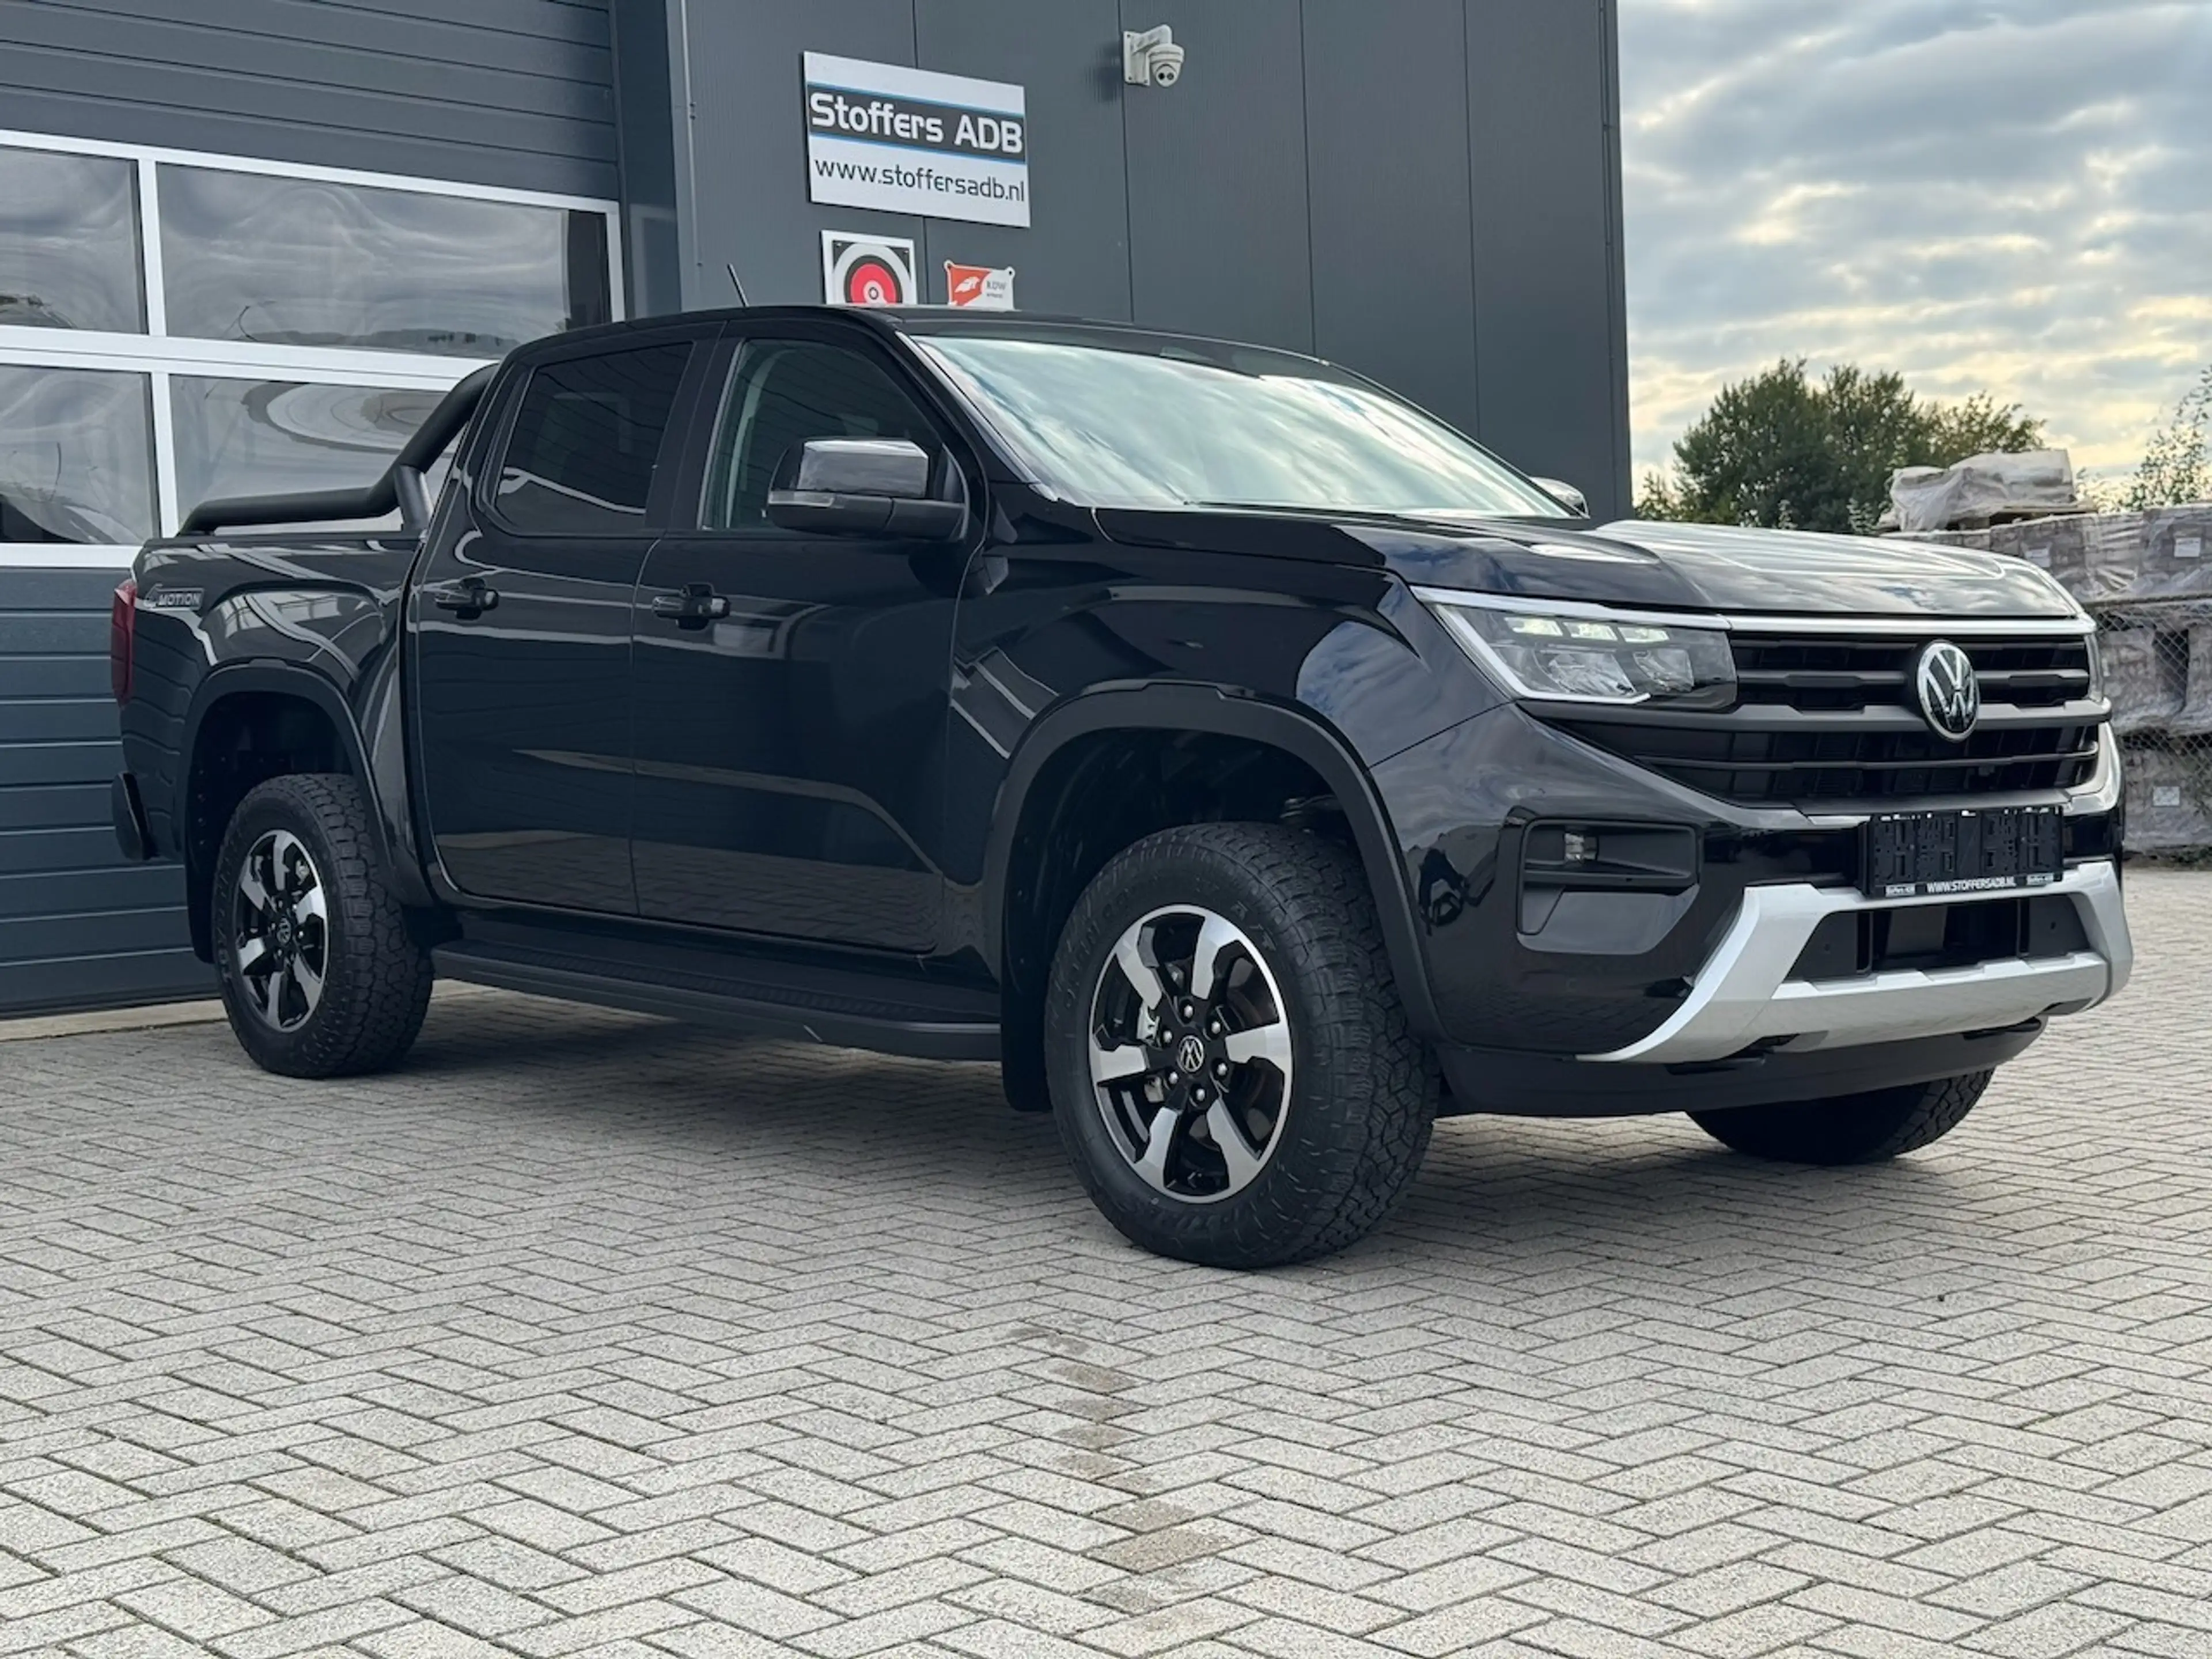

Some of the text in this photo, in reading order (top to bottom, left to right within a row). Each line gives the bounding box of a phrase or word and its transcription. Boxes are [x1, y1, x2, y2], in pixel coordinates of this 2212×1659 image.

[810, 92, 1022, 153] Stoffers ADB
[815, 158, 1024, 202] www.stoffersadb.nl
